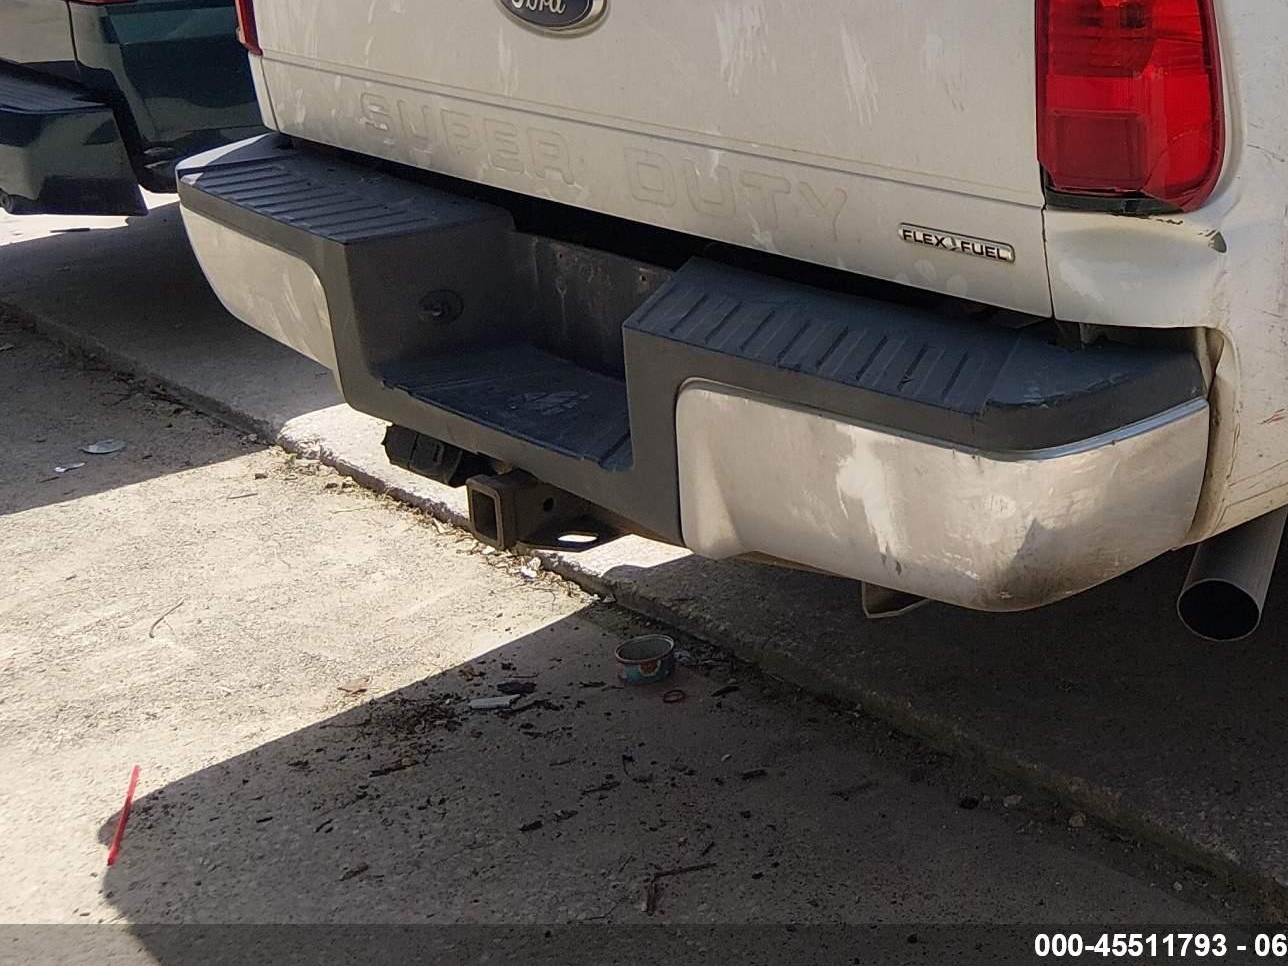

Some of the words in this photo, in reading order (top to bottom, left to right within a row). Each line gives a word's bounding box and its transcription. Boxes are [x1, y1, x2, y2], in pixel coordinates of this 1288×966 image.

[359, 90, 576, 186] SUPER
[621, 146, 848, 243] DUTY
[902, 228, 948, 250] FLEX
[960, 240, 1008, 261] FUEL
